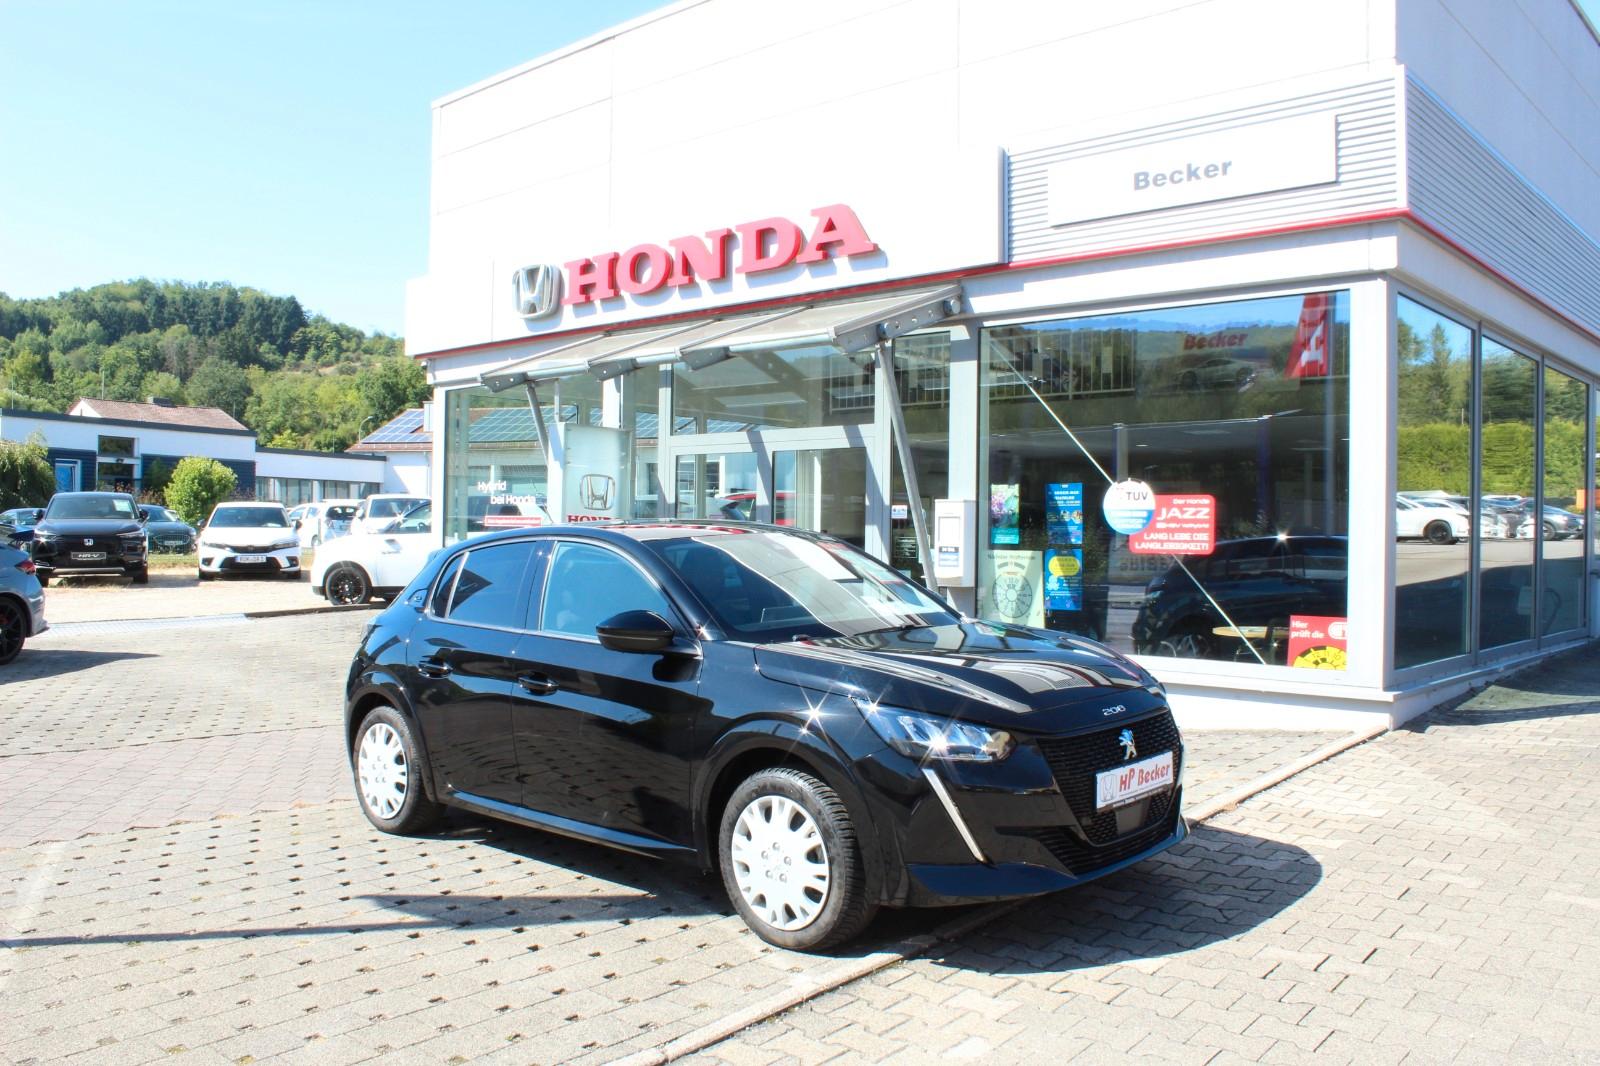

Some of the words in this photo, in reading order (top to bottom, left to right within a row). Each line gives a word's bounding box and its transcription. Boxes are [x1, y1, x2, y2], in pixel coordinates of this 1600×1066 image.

[1133, 161, 1232, 191] Becker
[562, 203, 878, 304] HONDA
[1183, 331, 1249, 350] Becker
[477, 480, 507, 494] Hybrid
[490, 495, 505, 505] bei
[506, 495, 537, 505] Honda
[1156, 507, 1210, 521] JAZZ
[1143, 532, 1168, 541] LANG
[1292, 620, 1309, 629] Hier
[1311, 630, 1325, 639] die
[1102, 705, 1126, 716] 208
[1118, 767, 1136, 793] HP
[1137, 763, 1171, 785] Becker
